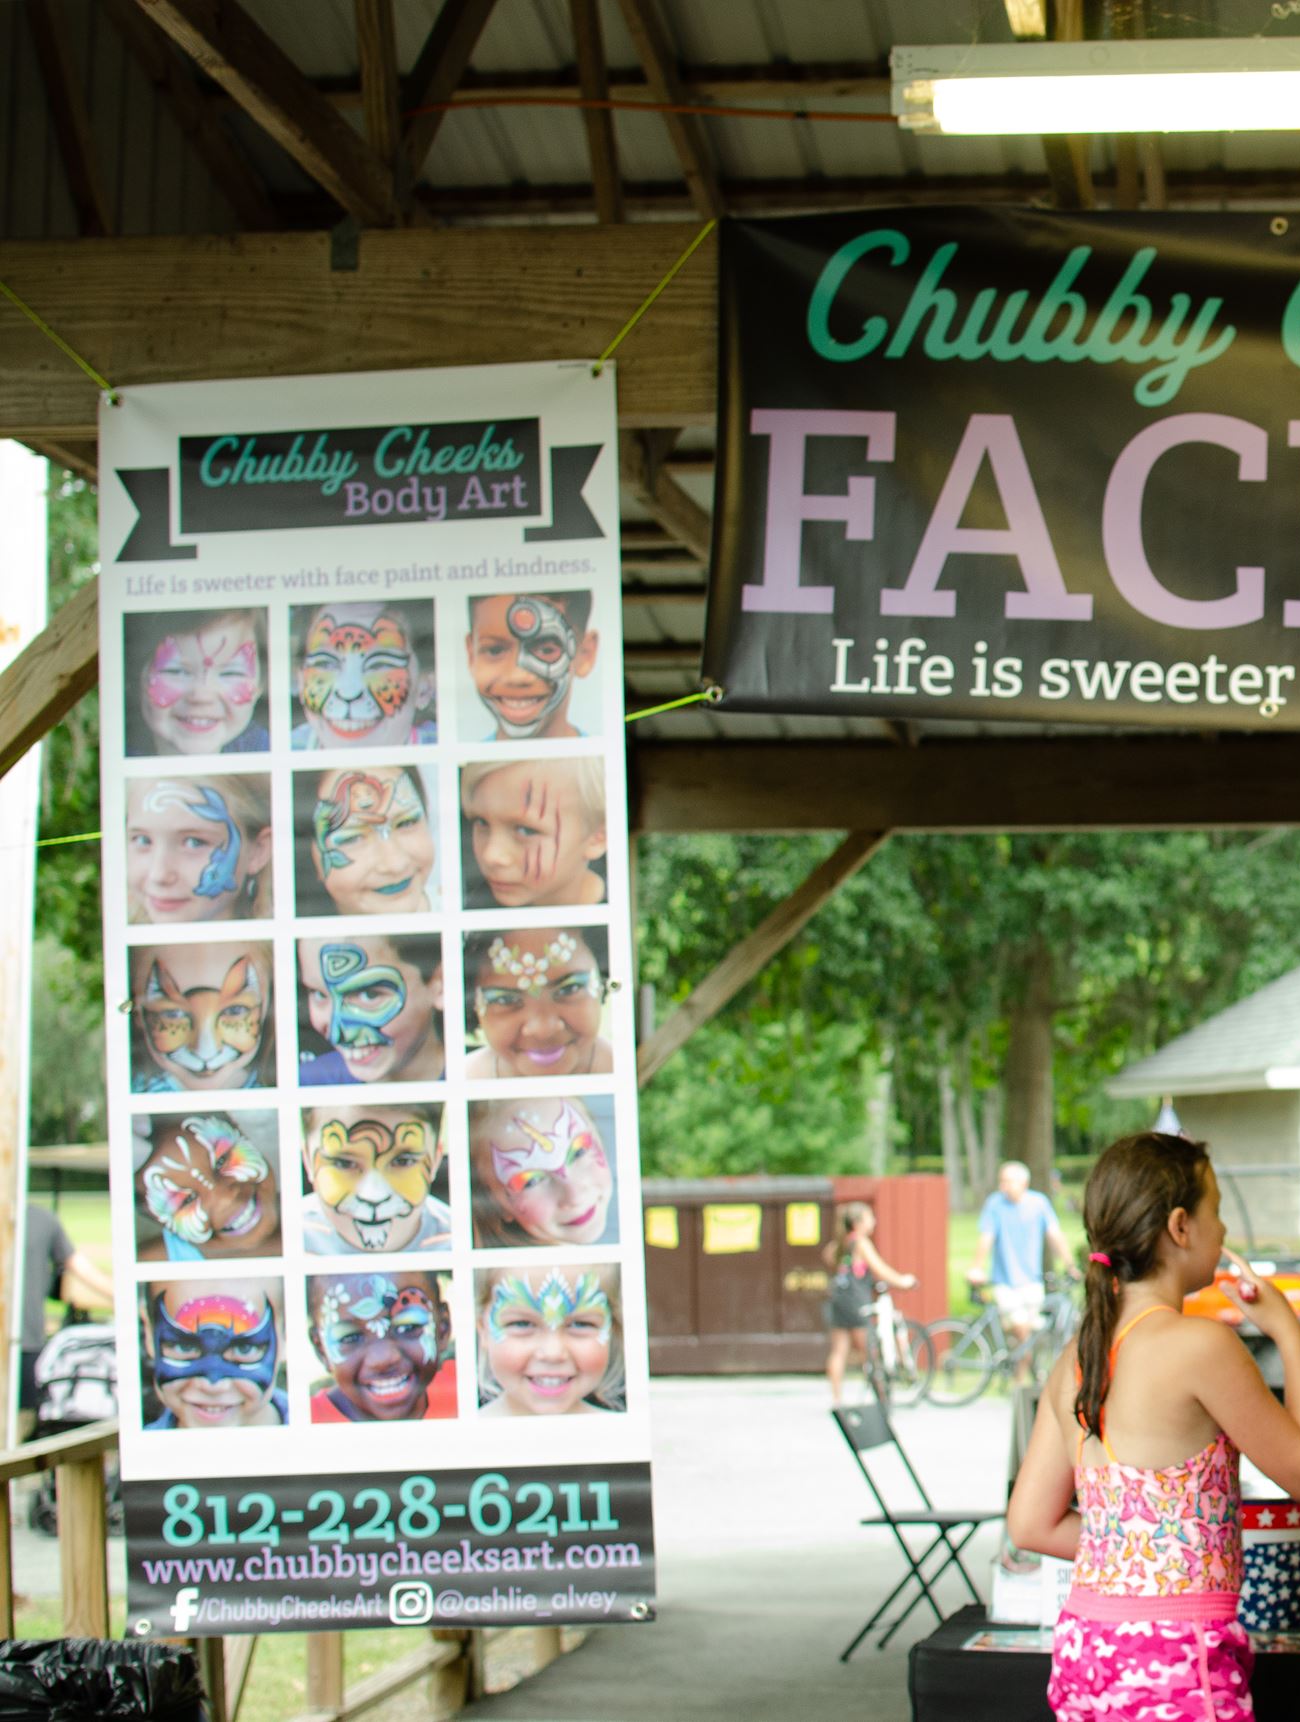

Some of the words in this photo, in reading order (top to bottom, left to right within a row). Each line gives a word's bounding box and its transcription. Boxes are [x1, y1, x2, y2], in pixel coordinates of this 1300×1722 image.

[805, 229, 1237, 407] Chubby
[200, 434, 359, 496] Chubby
[373, 424, 525, 478] Cheeks
[344, 477, 448, 521] Body
[457, 474, 529, 511] Art
[125, 575, 166, 596] Life
[171, 574, 189, 595] is
[194, 572, 277, 594] sweeter
[282, 567, 330, 590] with
[335, 565, 380, 587] face
[384, 564, 443, 590] paint
[447, 560, 489, 581] and
[494, 555, 597, 579] kindness.
[830, 638, 955, 697] Life
[970, 640, 1024, 700] is
[1039, 652, 1295, 707] sweeter
[162, 1472, 619, 1547] 812-228-6211
[142, 1540, 642, 1587] www.chubbycheeksart.com
[436, 1584, 617, 1619] @ashlie_alvey
